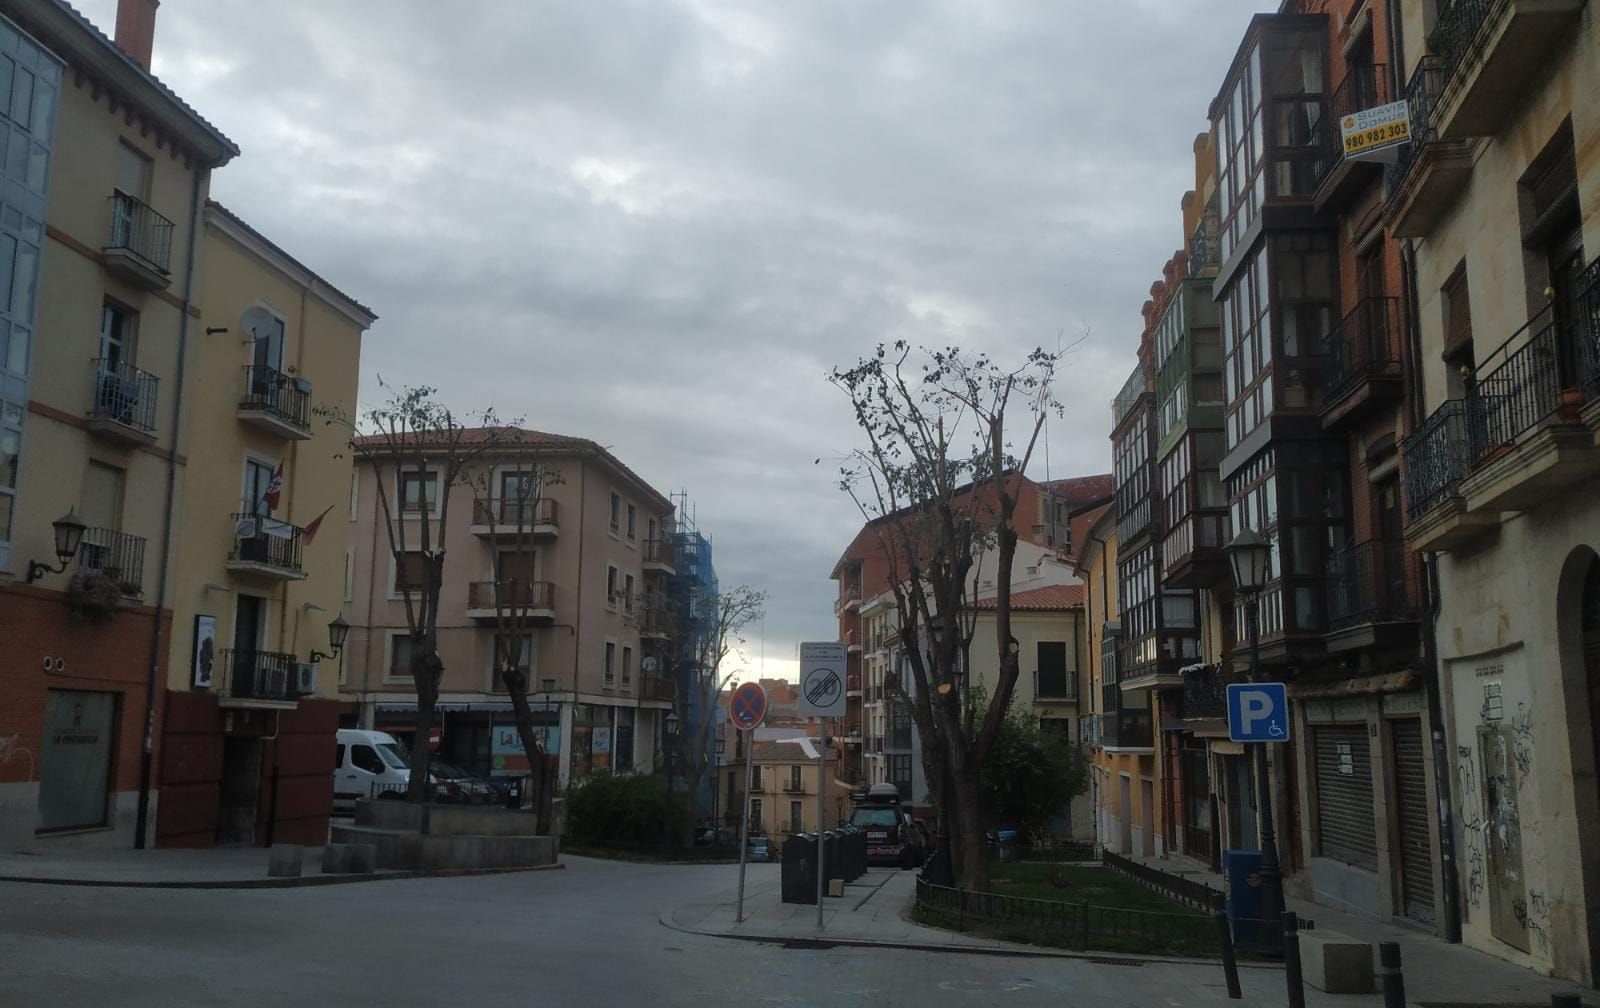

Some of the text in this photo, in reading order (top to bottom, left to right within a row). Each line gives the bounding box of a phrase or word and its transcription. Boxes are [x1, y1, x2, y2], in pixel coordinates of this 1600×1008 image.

[1358, 102, 1405, 121] SUAVIS
[1358, 111, 1406, 130] DOMUS
[1346, 133, 1365, 149] 980
[1367, 128, 1386, 143] 982
[1388, 122, 1408, 138] 303
[1239, 691, 1275, 735] P
